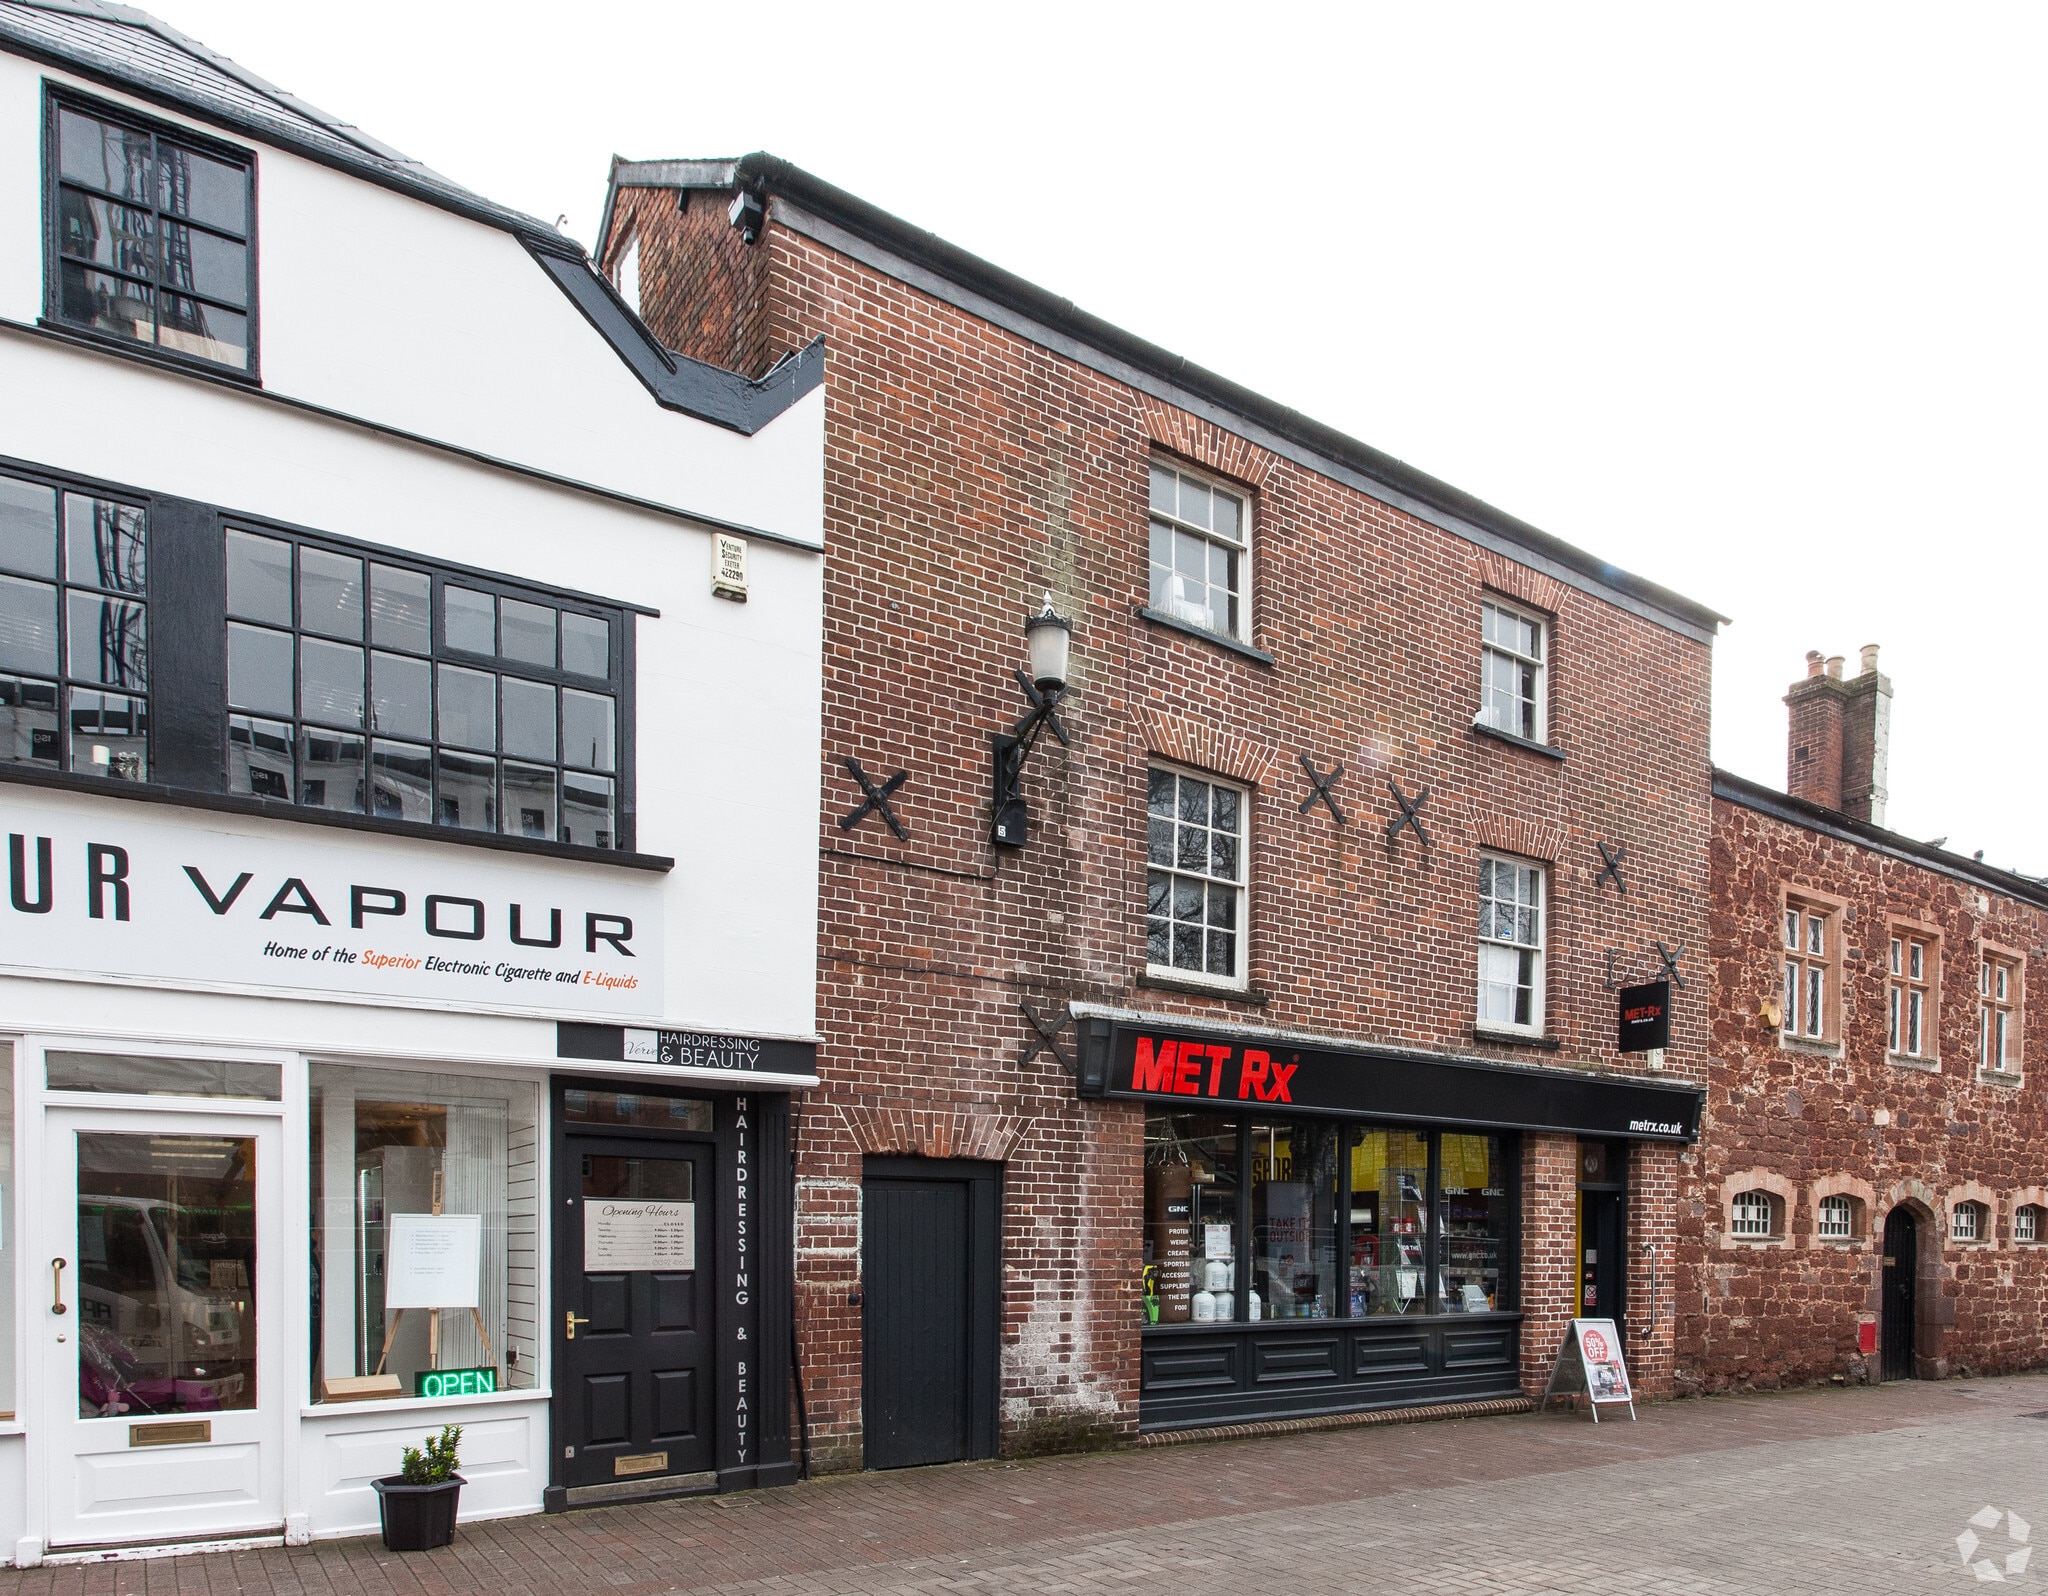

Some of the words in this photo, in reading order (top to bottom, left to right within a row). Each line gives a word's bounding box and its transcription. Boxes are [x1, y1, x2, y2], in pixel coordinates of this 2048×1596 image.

[721, 549, 742, 562] SECURITY
[724, 559, 740, 569] EXETER
[181, 865, 637, 957] VAPOUR
[263, 941, 308, 961] Home
[312, 945, 330, 962] of
[333, 948, 357, 964] the
[361, 949, 422, 970] Superior
[425, 955, 491, 977] Electronic
[495, 962, 553, 984] Cigarette
[555, 970, 580, 985] and
[583, 971, 639, 990] E-Liquids
[660, 1031, 760, 1052] HAIRDRESSING
[660, 1045, 674, 1064] &
[680, 1047, 760, 1070] BEAUTY
[1132, 1036, 1232, 1097] MET
[1629, 1120, 1683, 1135] metrx.co.uk
[1445, 1186, 1469, 1196] GNC
[1481, 1188, 1505, 1197] GNC
[735, 1097, 749, 1305] HAIRDRESSING
[602, 1205, 643, 1219] Opening
[645, 1204, 680, 1218] Hours
[1167, 1205, 1189, 1213] GNC
[1269, 1217, 1296, 1229] TAKE
[1269, 1230, 1312, 1243] OUTSIDE
[1451, 1251, 1498, 1261] www.gnc.co.uk
[1163, 1260, 1185, 1268] SPORTS
[1167, 1293, 1180, 1301] THE
[736, 1327, 748, 1341] &
[1585, 1337, 1604, 1348] 50%
[1588, 1347, 1605, 1358] OFF
[423, 1370, 495, 1398] OPEN
[736, 1361, 749, 1463] BEAUTY
